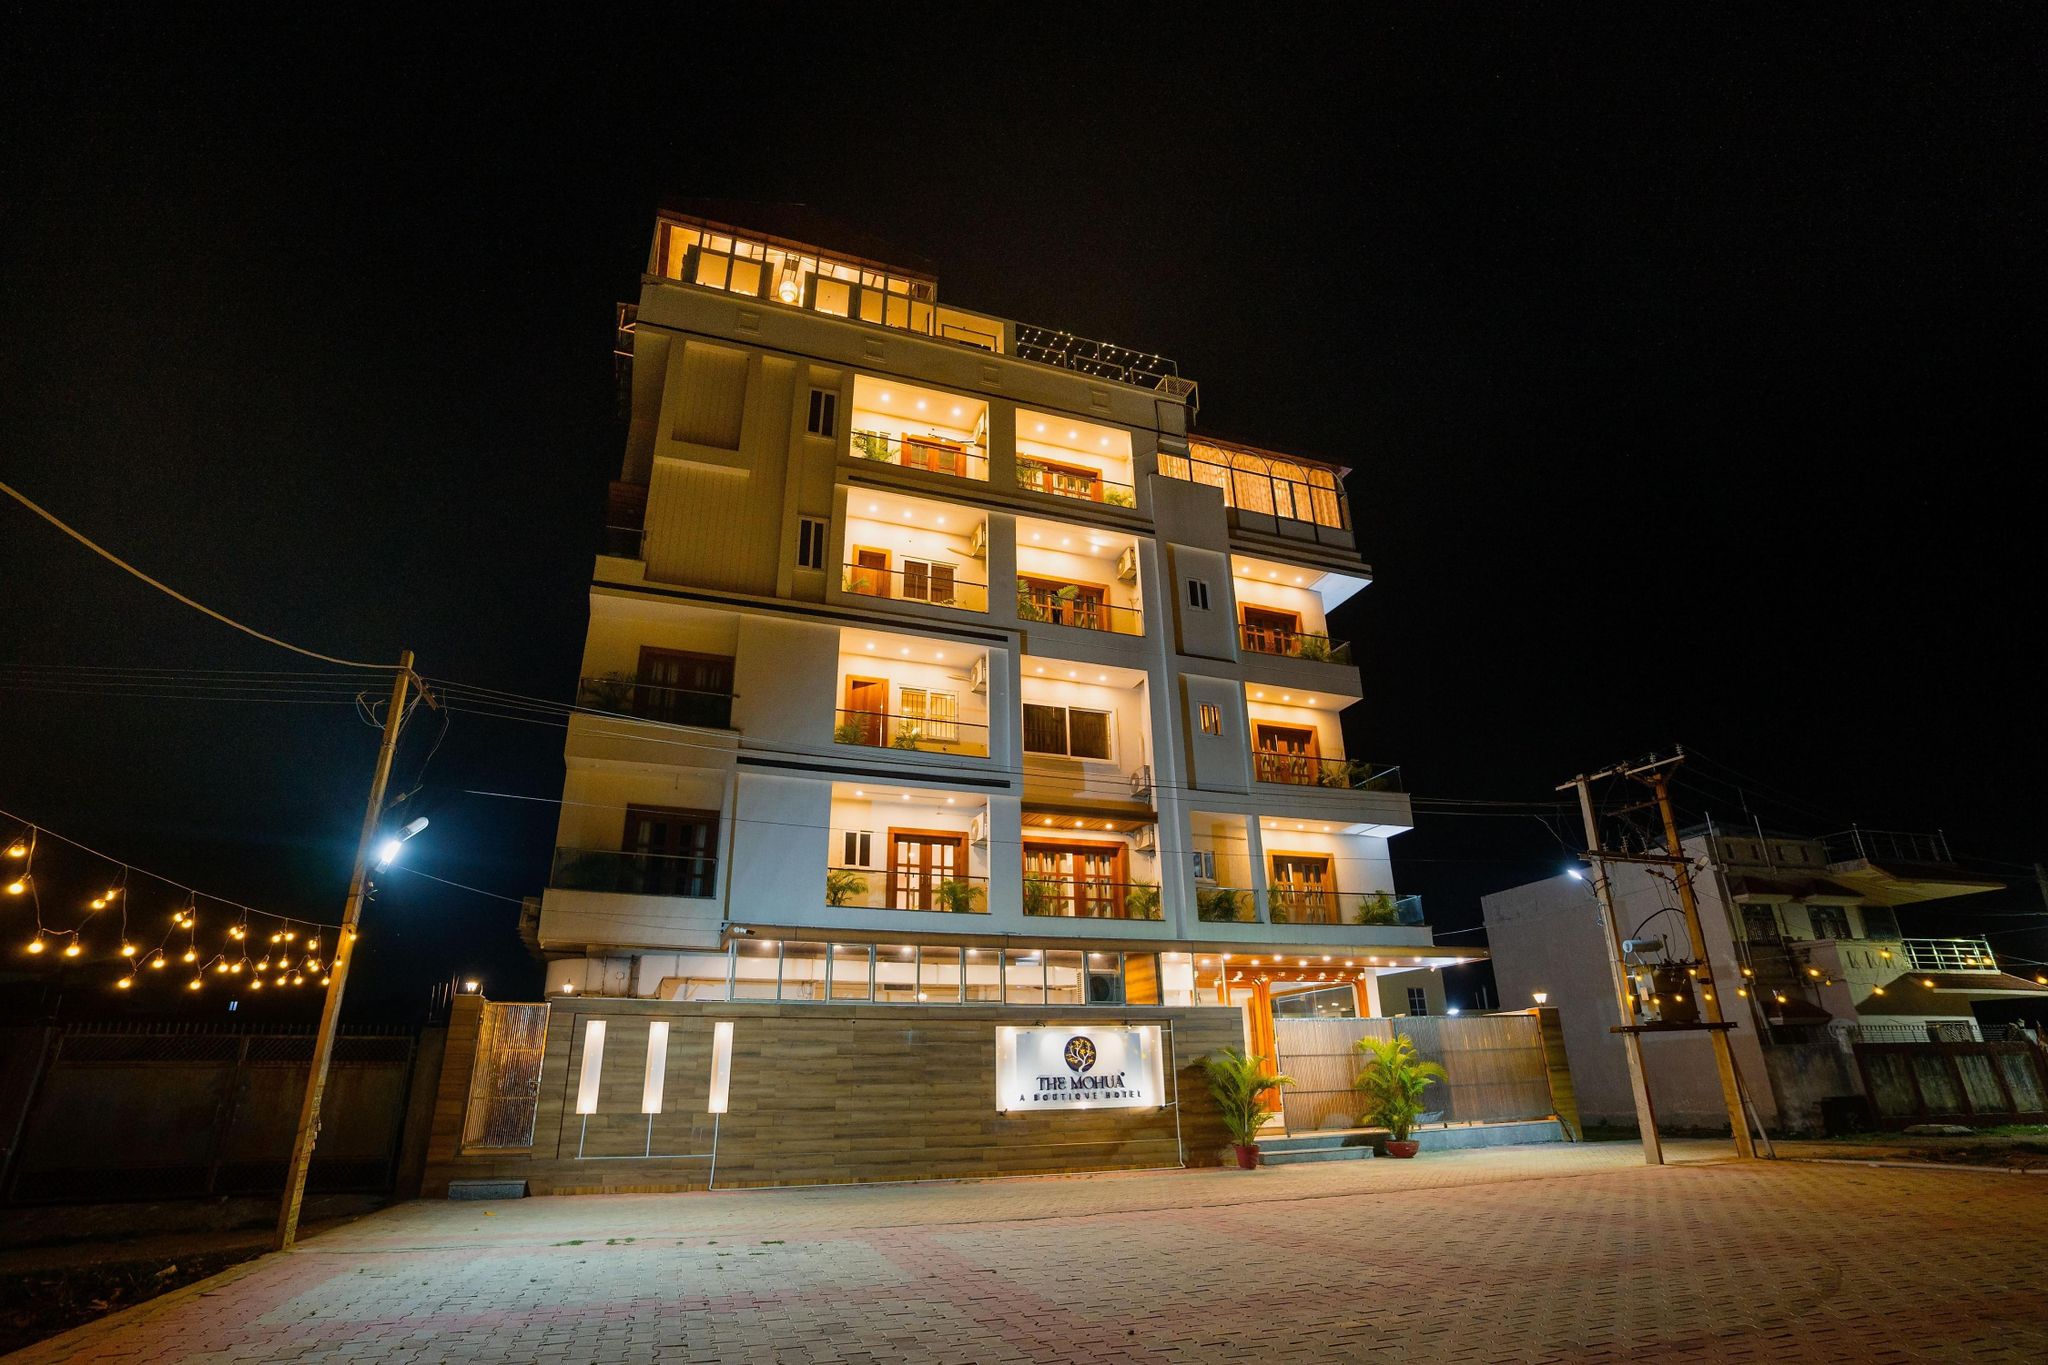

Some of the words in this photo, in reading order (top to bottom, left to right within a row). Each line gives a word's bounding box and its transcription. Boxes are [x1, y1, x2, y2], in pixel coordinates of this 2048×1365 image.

[1036, 1076, 1066, 1090] THE
[1070, 1074, 1125, 1089] MOHUA
[1033, 1092, 1098, 1102] BOUTIQUE
[1105, 1090, 1142, 1100] HOTEL
